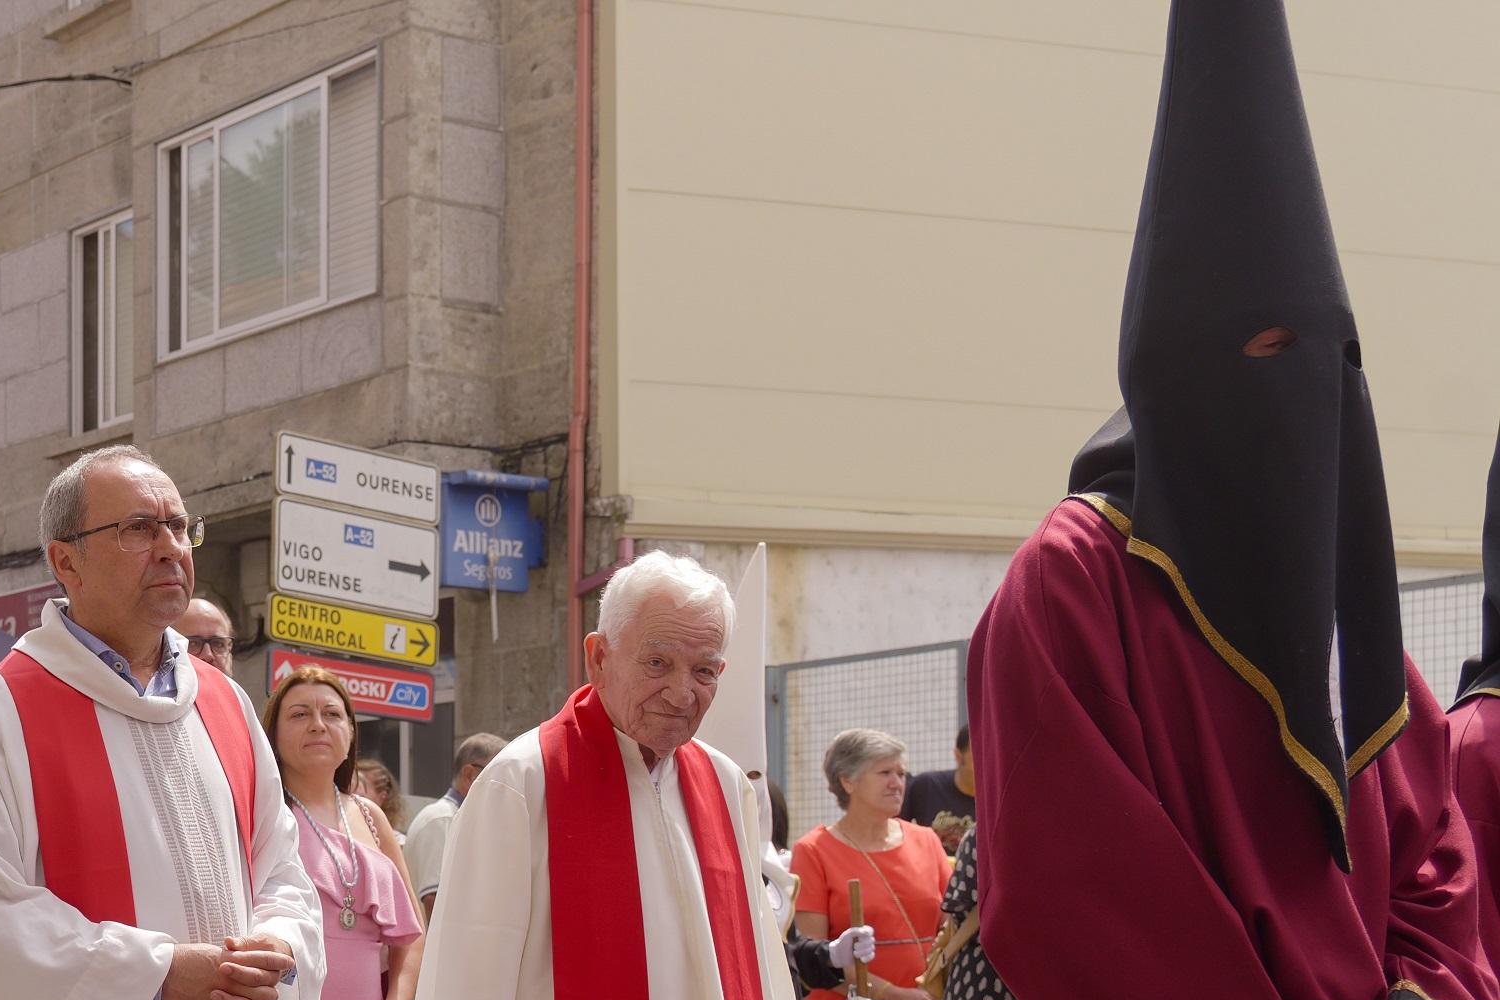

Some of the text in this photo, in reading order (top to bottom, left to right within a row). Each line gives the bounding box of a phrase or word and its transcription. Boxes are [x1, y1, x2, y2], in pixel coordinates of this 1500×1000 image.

[307, 461, 433, 501] A-52 OURENSE
[345, 525, 373, 546] A-52
[453, 529, 523, 558] Allianz
[283, 540, 323, 561] VIGO
[281, 565, 362, 593] OURENSE
[277, 600, 341, 625] CENTRO
[276, 620, 366, 650] COMARCAL
[339, 676, 420, 705] ROSKI city
